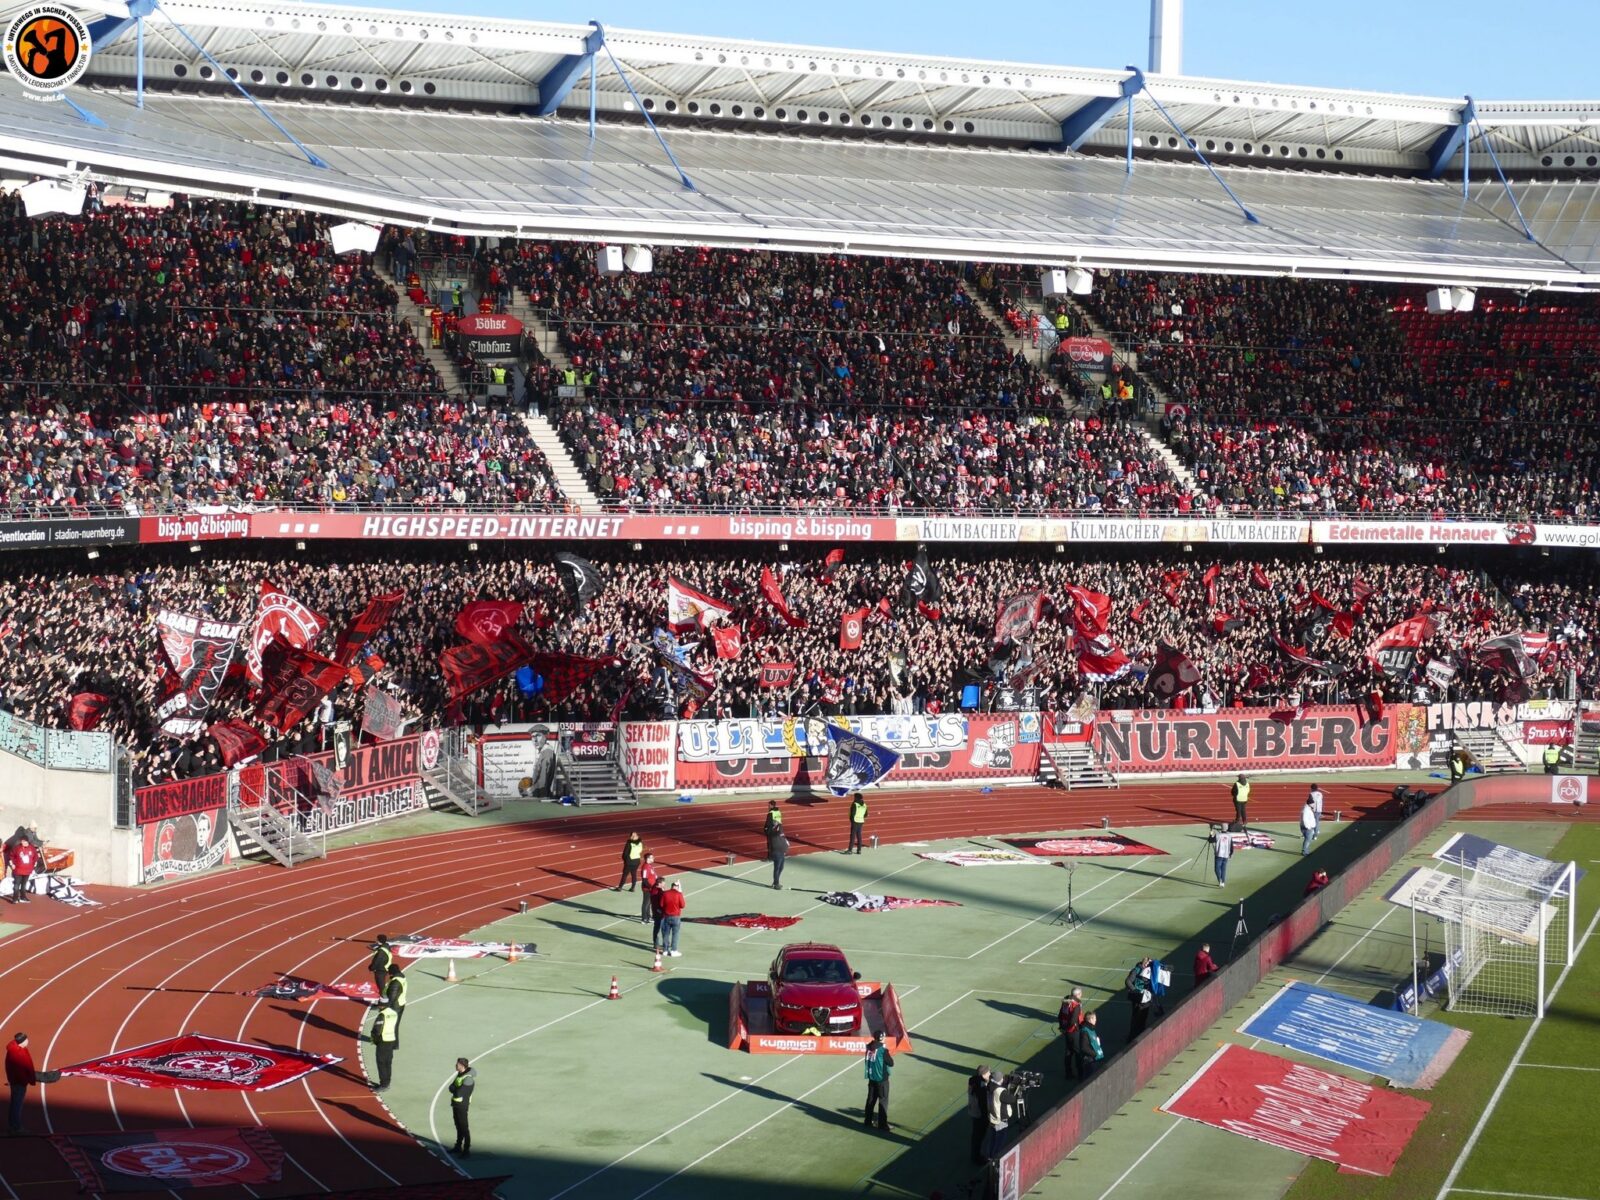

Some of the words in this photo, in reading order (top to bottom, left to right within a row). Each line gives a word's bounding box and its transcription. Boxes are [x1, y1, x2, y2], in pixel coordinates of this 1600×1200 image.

[54, 526, 125, 540] stadion-nuernberg.de
[209, 515, 248, 538] bisping
[363, 517, 624, 537] HIGHSPEED-INTERNET
[729, 518, 792, 540] bisping
[795, 518, 808, 536] &
[810, 518, 872, 540] bisping
[1429, 525, 1498, 542] Hanauer
[1544, 531, 1600, 547] www.gol
[765, 668, 792, 683] UN
[625, 723, 670, 743] SEKTION
[1096, 710, 1390, 763] NÜRNBERG
[580, 744, 599, 756] RSR
[625, 747, 669, 766] STADION
[368, 741, 420, 782] AMICI
[626, 770, 669, 788] VERBOT
[136, 788, 167, 821] KAOS
[181, 777, 225, 812] BAGAGE
[1560, 787, 1579, 797] FCN
[759, 1037, 817, 1049] kummich
